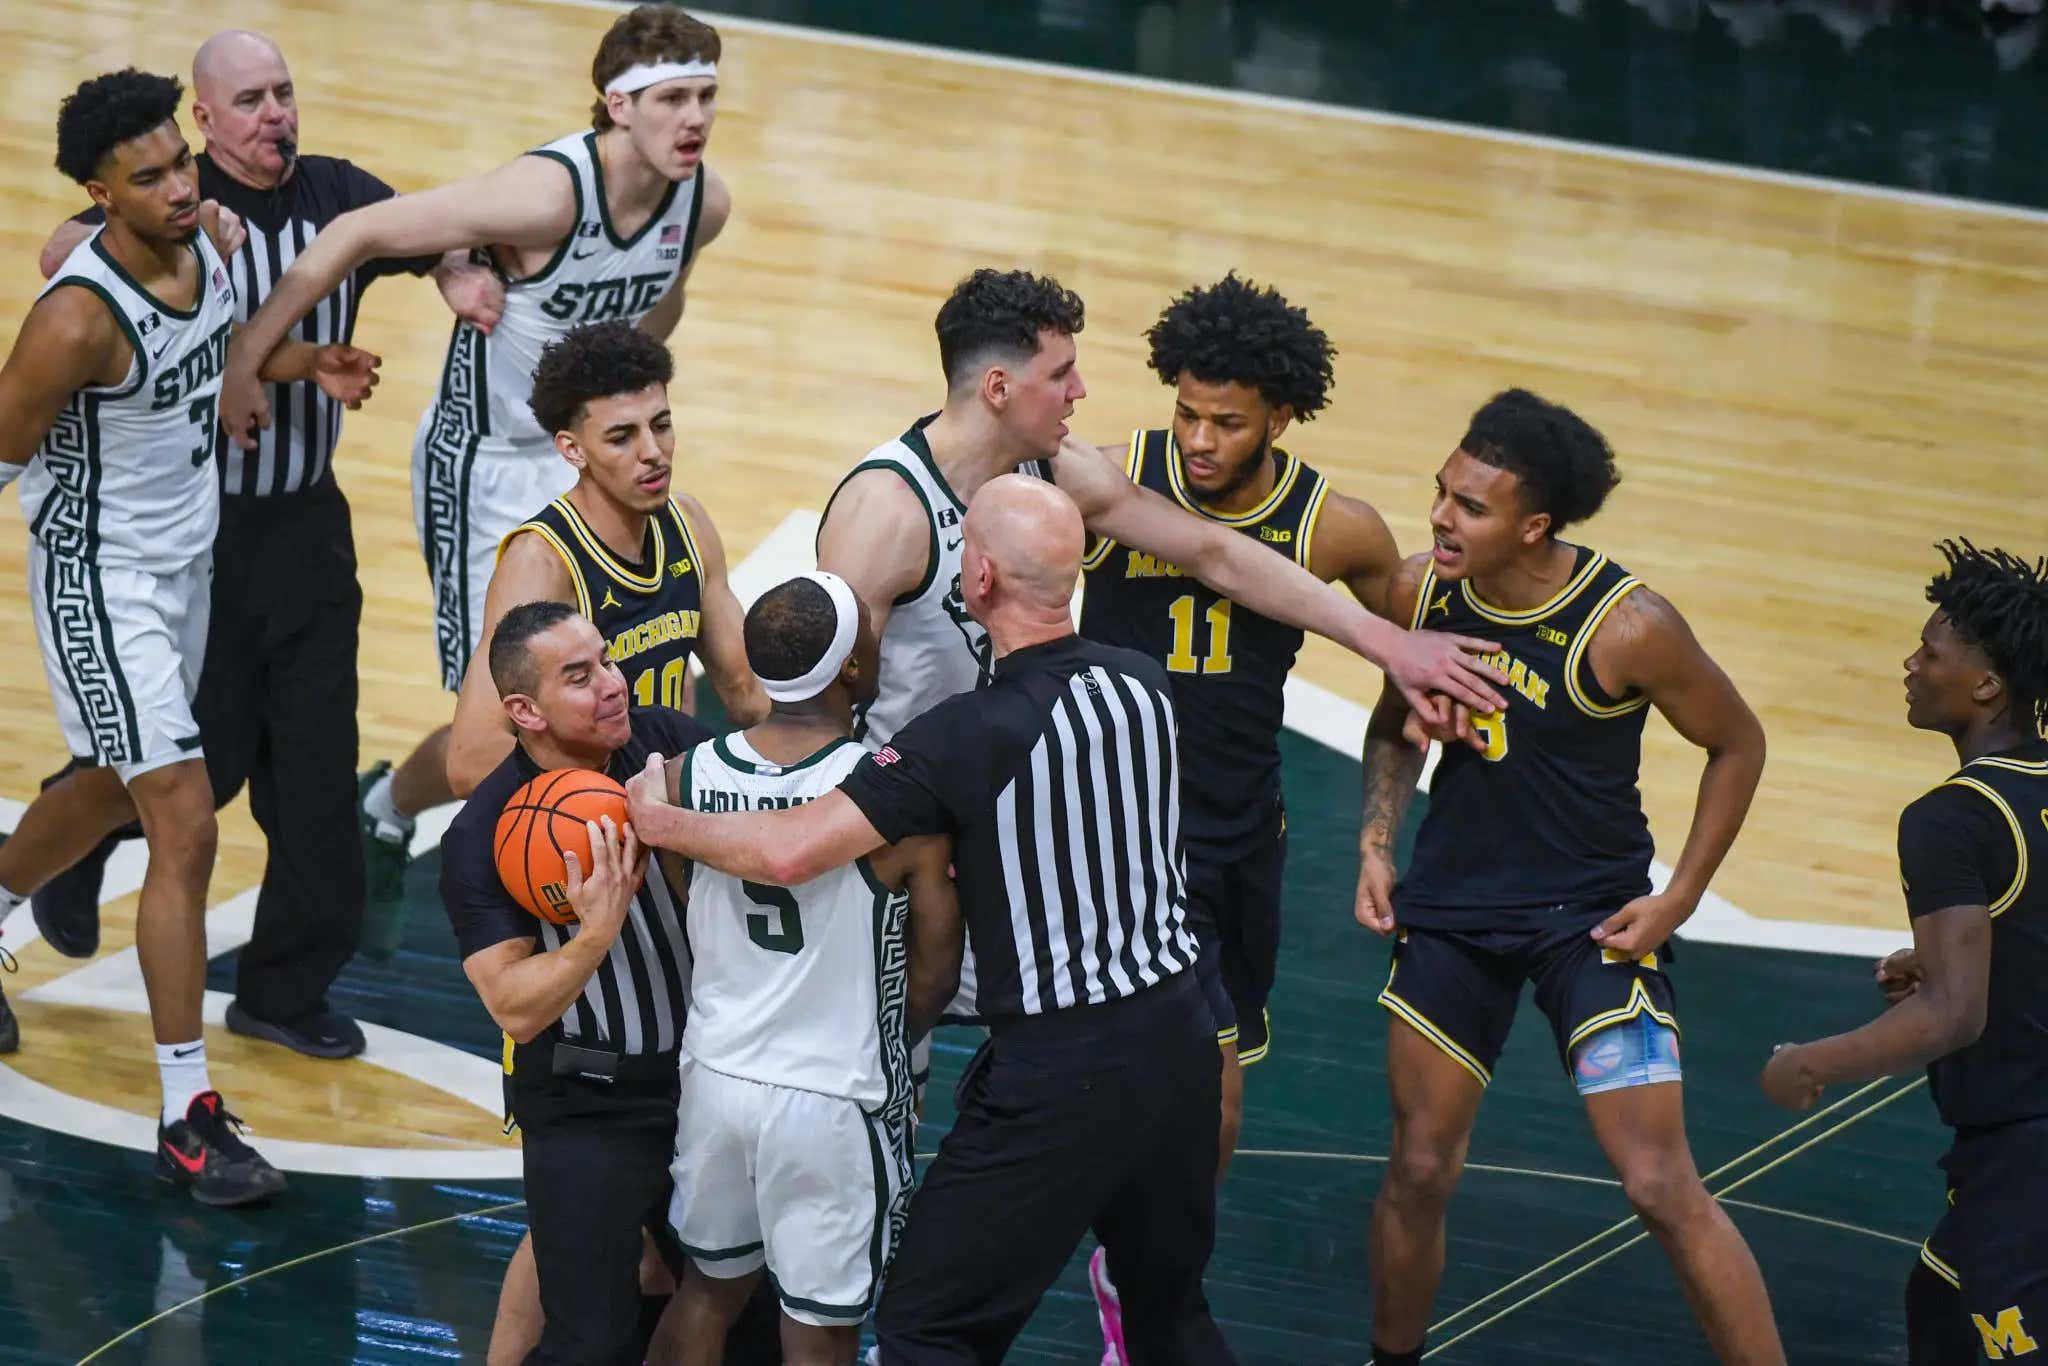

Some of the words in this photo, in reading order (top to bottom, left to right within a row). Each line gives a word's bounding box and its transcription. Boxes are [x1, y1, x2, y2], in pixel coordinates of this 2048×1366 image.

[540, 271, 674, 321] STATE
[189, 393, 218, 469] 3
[1259, 525, 1292, 544] B1G
[669, 558, 692, 578] B1G
[606, 609, 701, 664] MICHIGAN
[1166, 595, 1233, 675] 11
[1535, 623, 1568, 647] B1G
[633, 656, 685, 712] 10
[742, 879, 805, 955] 5
[1971, 1305, 2038, 1360] M
